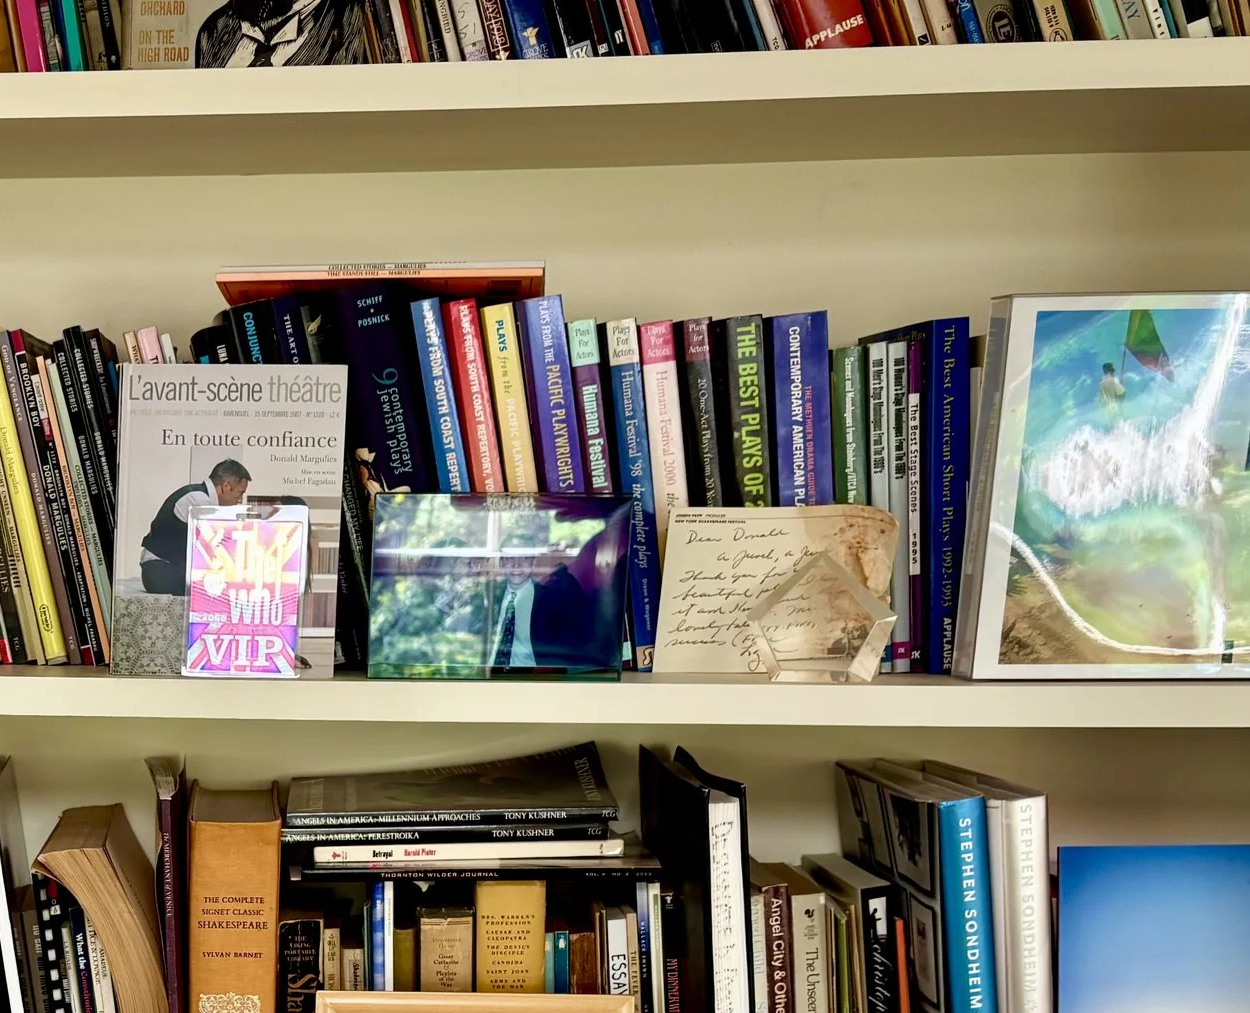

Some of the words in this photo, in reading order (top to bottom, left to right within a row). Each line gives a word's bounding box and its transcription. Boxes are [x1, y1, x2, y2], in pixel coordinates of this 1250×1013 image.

[139, 30, 151, 45] ON
[156, 29, 174, 44] THE
[805, 14, 865, 49] APPLAUSE
[138, 47, 160, 62] HIGH
[164, 47, 189, 62] ROAD
[357, 294, 383, 308] SCHIFF
[358, 314, 390, 328] POSNICK
[495, 320, 507, 353] PLAYS
[736, 323, 756, 358] THE
[943, 326, 954, 353] The
[267, 374, 342, 403] théâtre
[372, 368, 399, 385] 9
[467, 360, 480, 389] SOUTH
[546, 364, 564, 407] PACIFIC
[738, 364, 759, 408] BEST
[789, 326, 803, 424] CONTEMPORARY
[943, 359, 955, 388] Best
[20, 363, 36, 408] BROOKLYN
[31, 411, 41, 427] BOY
[377, 389, 396, 436] jewish
[472, 389, 485, 422] COAST
[582, 384, 600, 437] Humana
[161, 429, 185, 446] En
[194, 432, 240, 447] toute
[247, 431, 337, 448] confiance
[389, 387, 413, 473] contemporary
[741, 413, 762, 468] PLAYS
[943, 394, 954, 460] American
[270, 453, 297, 463] Donald
[300, 454, 337, 465] Margulies
[386, 438, 400, 476] plays
[476, 424, 491, 478] REPERTORY,
[551, 409, 574, 488] PLAYWRIGHTS
[587, 438, 605, 489] Festival
[792, 425, 805, 486] AMERICAN
[743, 473, 764, 495] OF
[942, 465, 954, 502] Short
[42, 465, 56, 500] DONALD
[51, 502, 68, 551] MARGULIES
[942, 507, 953, 542] Plays
[686, 530, 722, 544] Dear
[201, 633, 283, 667] VIP
[943, 617, 952, 669] APPLAUSE
[504, 811, 526, 820] TONY
[528, 811, 567, 820] KUSHNER
[959, 818, 976, 901] STEPHEN
[198, 921, 268, 929] SHAKESPEARE
[769, 897, 782, 938] Angel
[772, 941, 785, 967] City
[965, 905, 984, 1012] SONDHEIM
[773, 970, 781, 981] &
